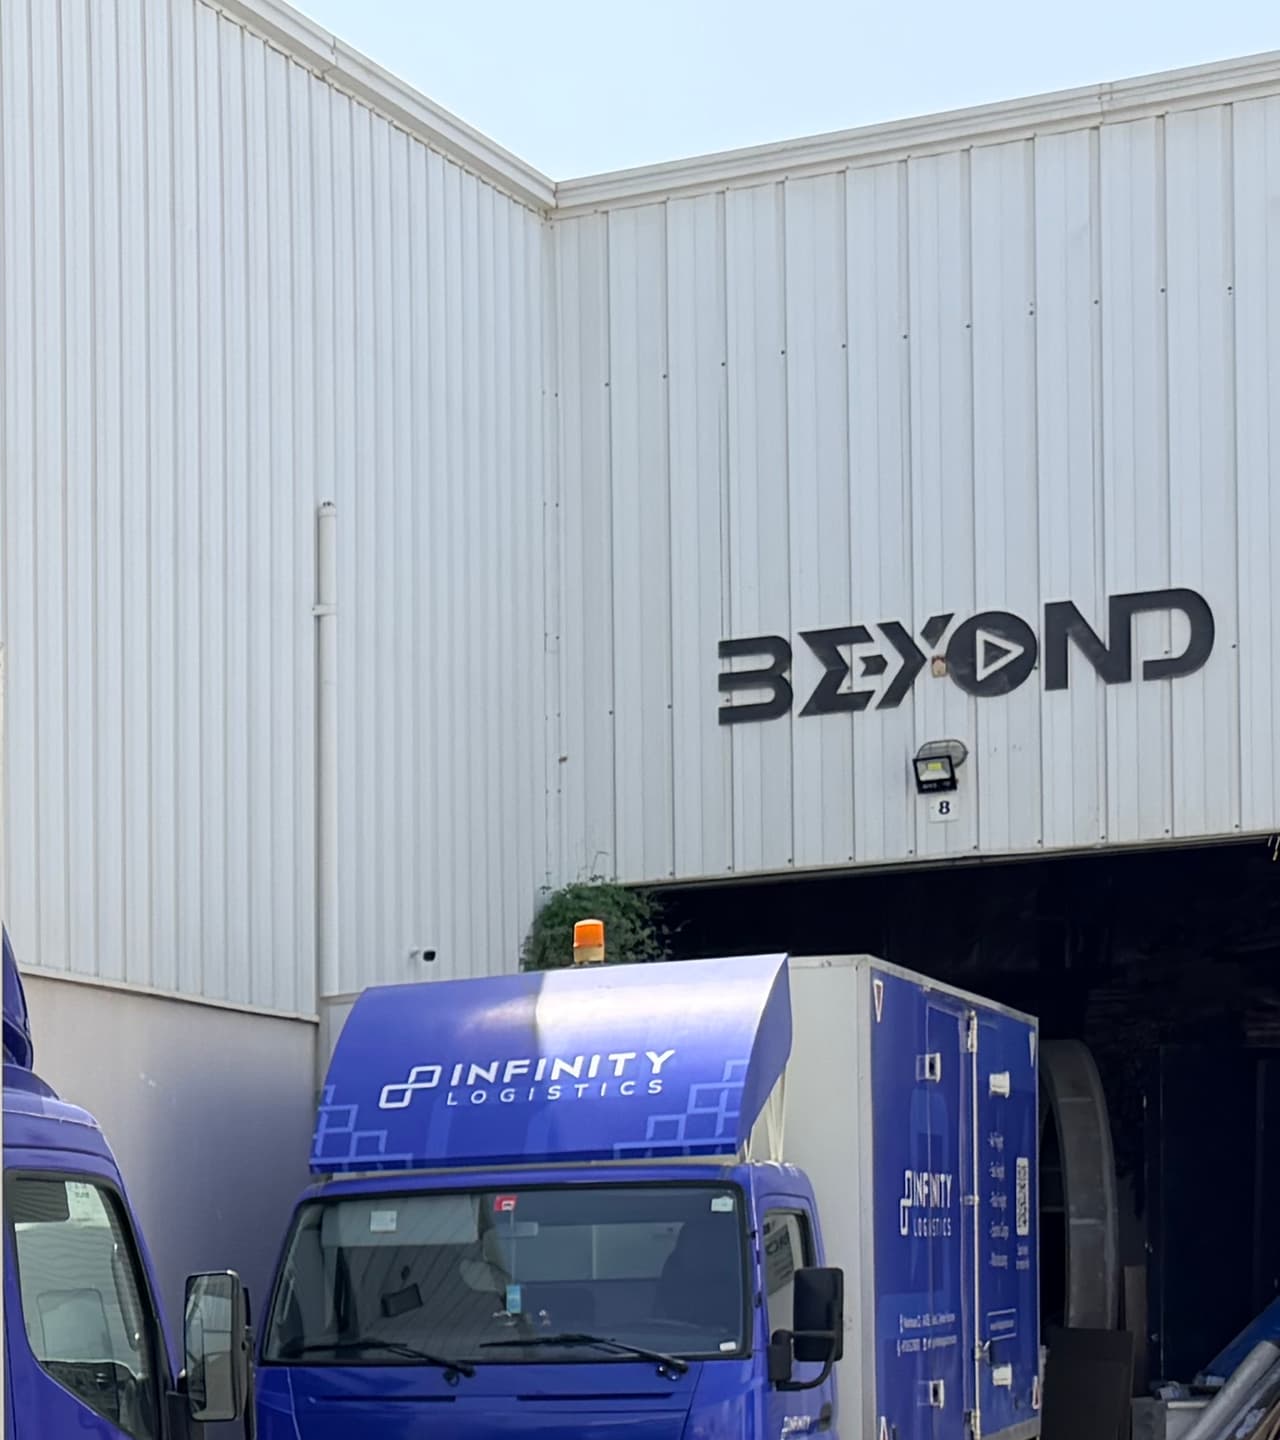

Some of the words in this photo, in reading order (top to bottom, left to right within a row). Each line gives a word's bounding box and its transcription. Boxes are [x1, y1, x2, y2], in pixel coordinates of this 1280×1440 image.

[718, 587, 1215, 726] BEYOND
[939, 800, 950, 815] 8
[450, 1049, 676, 1087] INFINITY
[446, 1079, 663, 1106] LOGISTICS
[913, 1171, 952, 1208] INFINITY
